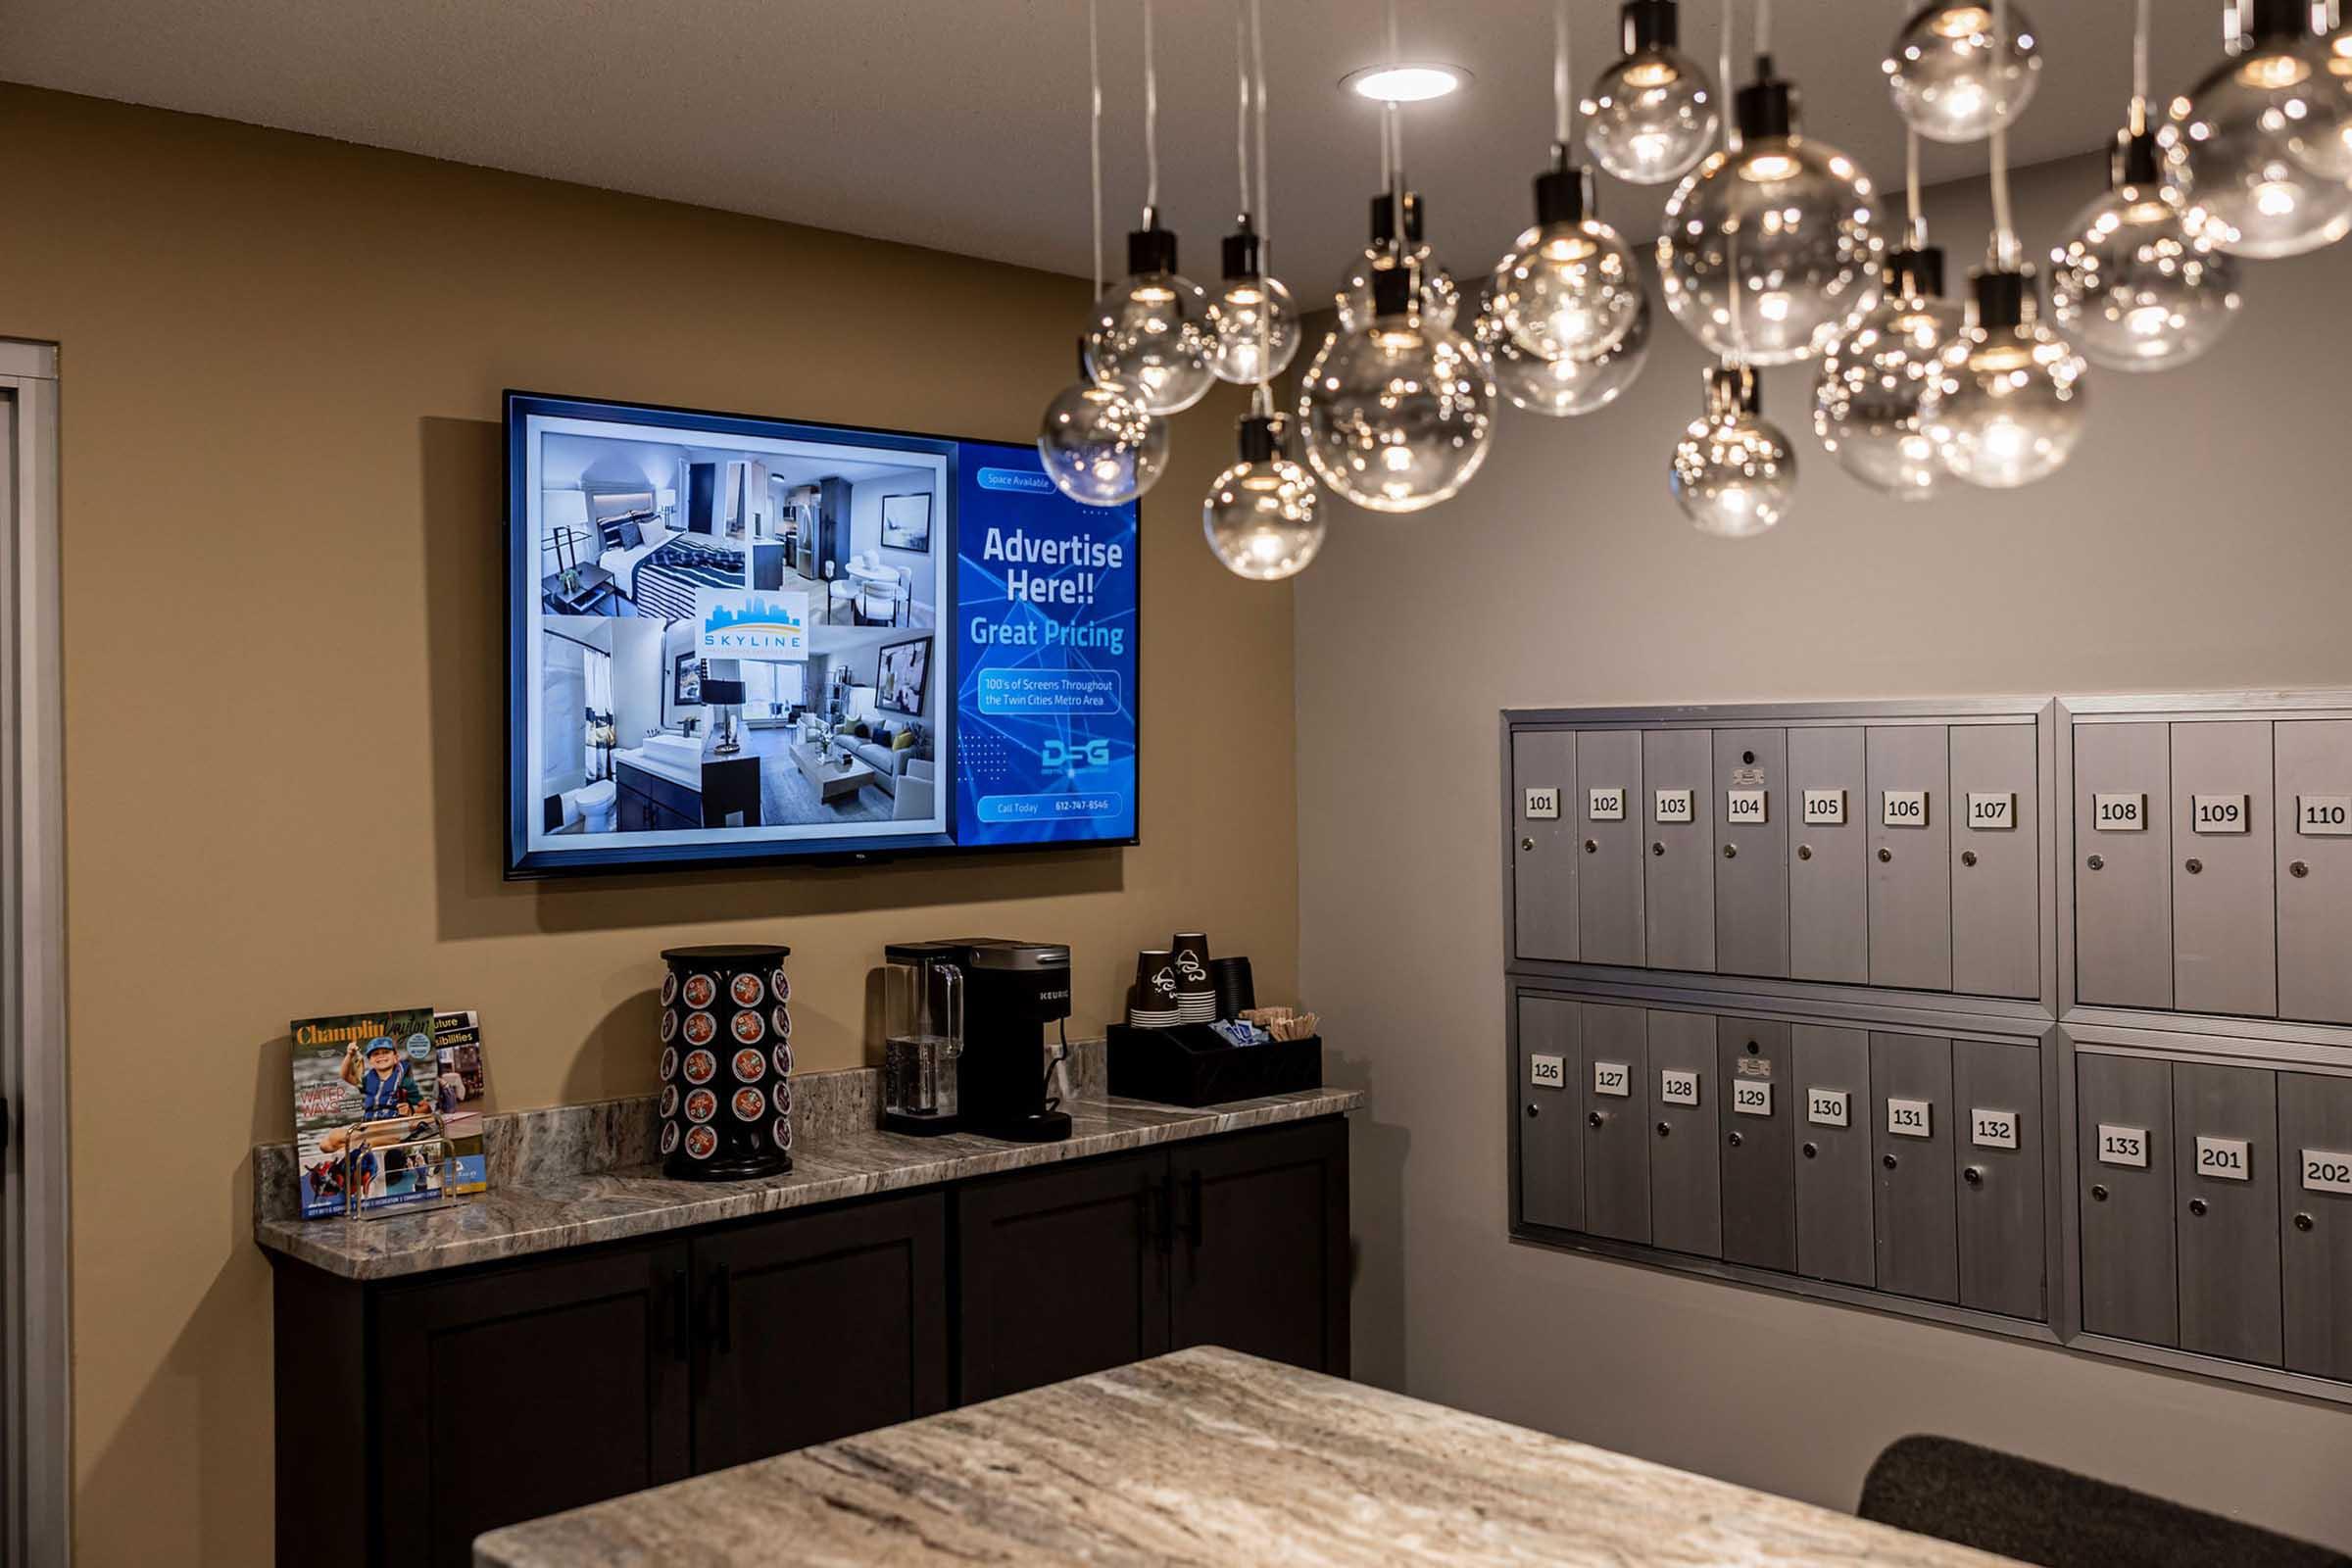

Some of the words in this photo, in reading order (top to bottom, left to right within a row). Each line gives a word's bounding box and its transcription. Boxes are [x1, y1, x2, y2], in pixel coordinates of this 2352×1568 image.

[987, 473, 1011, 487] Space
[1013, 475, 1050, 488] Available
[983, 527, 1122, 568] Advertise
[1007, 568, 1094, 605] Here!!
[705, 635, 801, 648] SKYLINE
[971, 616, 1038, 645] Great
[1045, 619, 1124, 656] Pricing
[986, 678, 1010, 690] 100's
[1010, 678, 1022, 690] of
[1023, 678, 1059, 691] Screens
[1061, 679, 1112, 693] Throughout
[986, 694, 1002, 706] the
[1004, 694, 1027, 706] Twin
[1028, 694, 1054, 706] Cities
[1054, 695, 1082, 706] Metro
[1083, 695, 1104, 706] Area
[997, 803, 1012, 814] Call
[1015, 803, 1039, 814] Today
[1529, 796, 1552, 810] 101
[1592, 797, 1618, 811] 102
[1660, 799, 1686, 813] 103
[1732, 799, 1759, 814] 104
[1808, 799, 1838, 814] 105
[1888, 801, 1920, 816] 106
[1975, 802, 2007, 818] 107
[2101, 804, 2137, 820] 108
[2200, 805, 2238, 822] 109
[2306, 807, 2345, 824] 110
[434, 1018, 459, 1030] uture
[297, 1020, 385, 1045] Champlin
[435, 1032, 473, 1048] sibilities
[1535, 1063, 1558, 1079] 126
[1598, 1072, 1623, 1088] 127
[1666, 1080, 1692, 1097] 128
[1738, 1090, 1765, 1106] 129
[1813, 1099, 1842, 1116] 130
[1893, 1109, 1923, 1127] 131
[1978, 1120, 2011, 1139] 132
[2105, 1137, 2139, 1156] 133
[2202, 1149, 2241, 1169] 201
[2307, 1162, 2350, 1183] 202
